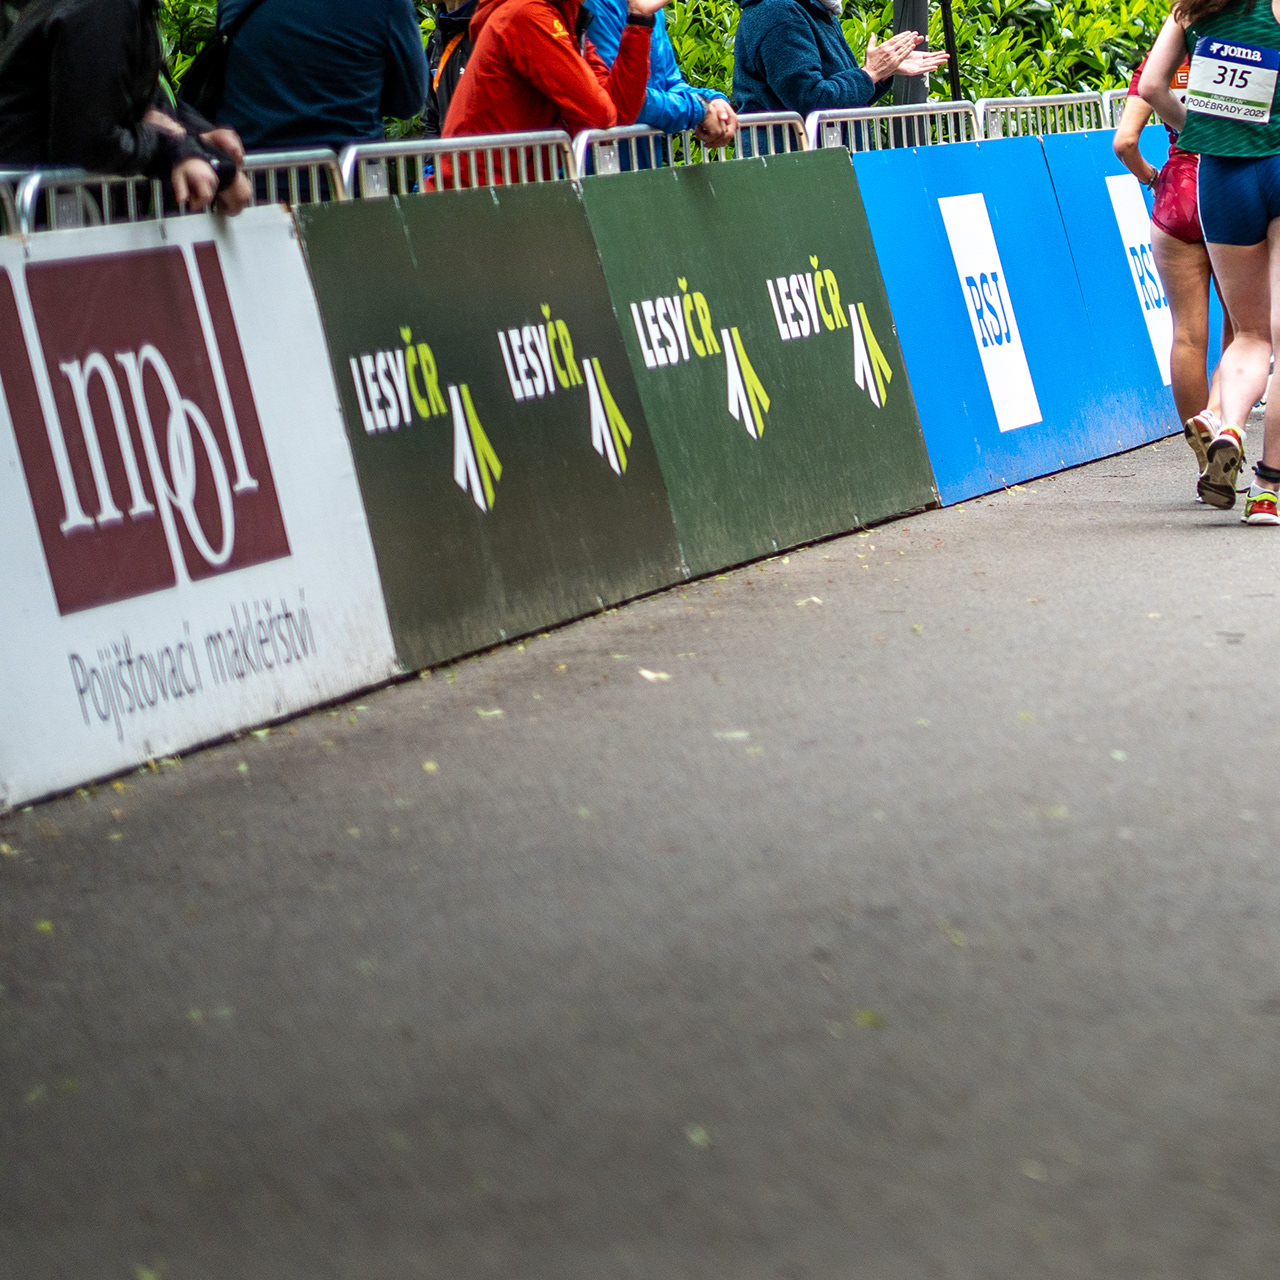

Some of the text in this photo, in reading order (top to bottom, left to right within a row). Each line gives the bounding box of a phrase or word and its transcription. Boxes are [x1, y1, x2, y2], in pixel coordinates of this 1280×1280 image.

[1212, 65, 1252, 89] 315
[1243, 108, 1266, 118] 2025
[964, 271, 1012, 348] RSJ
